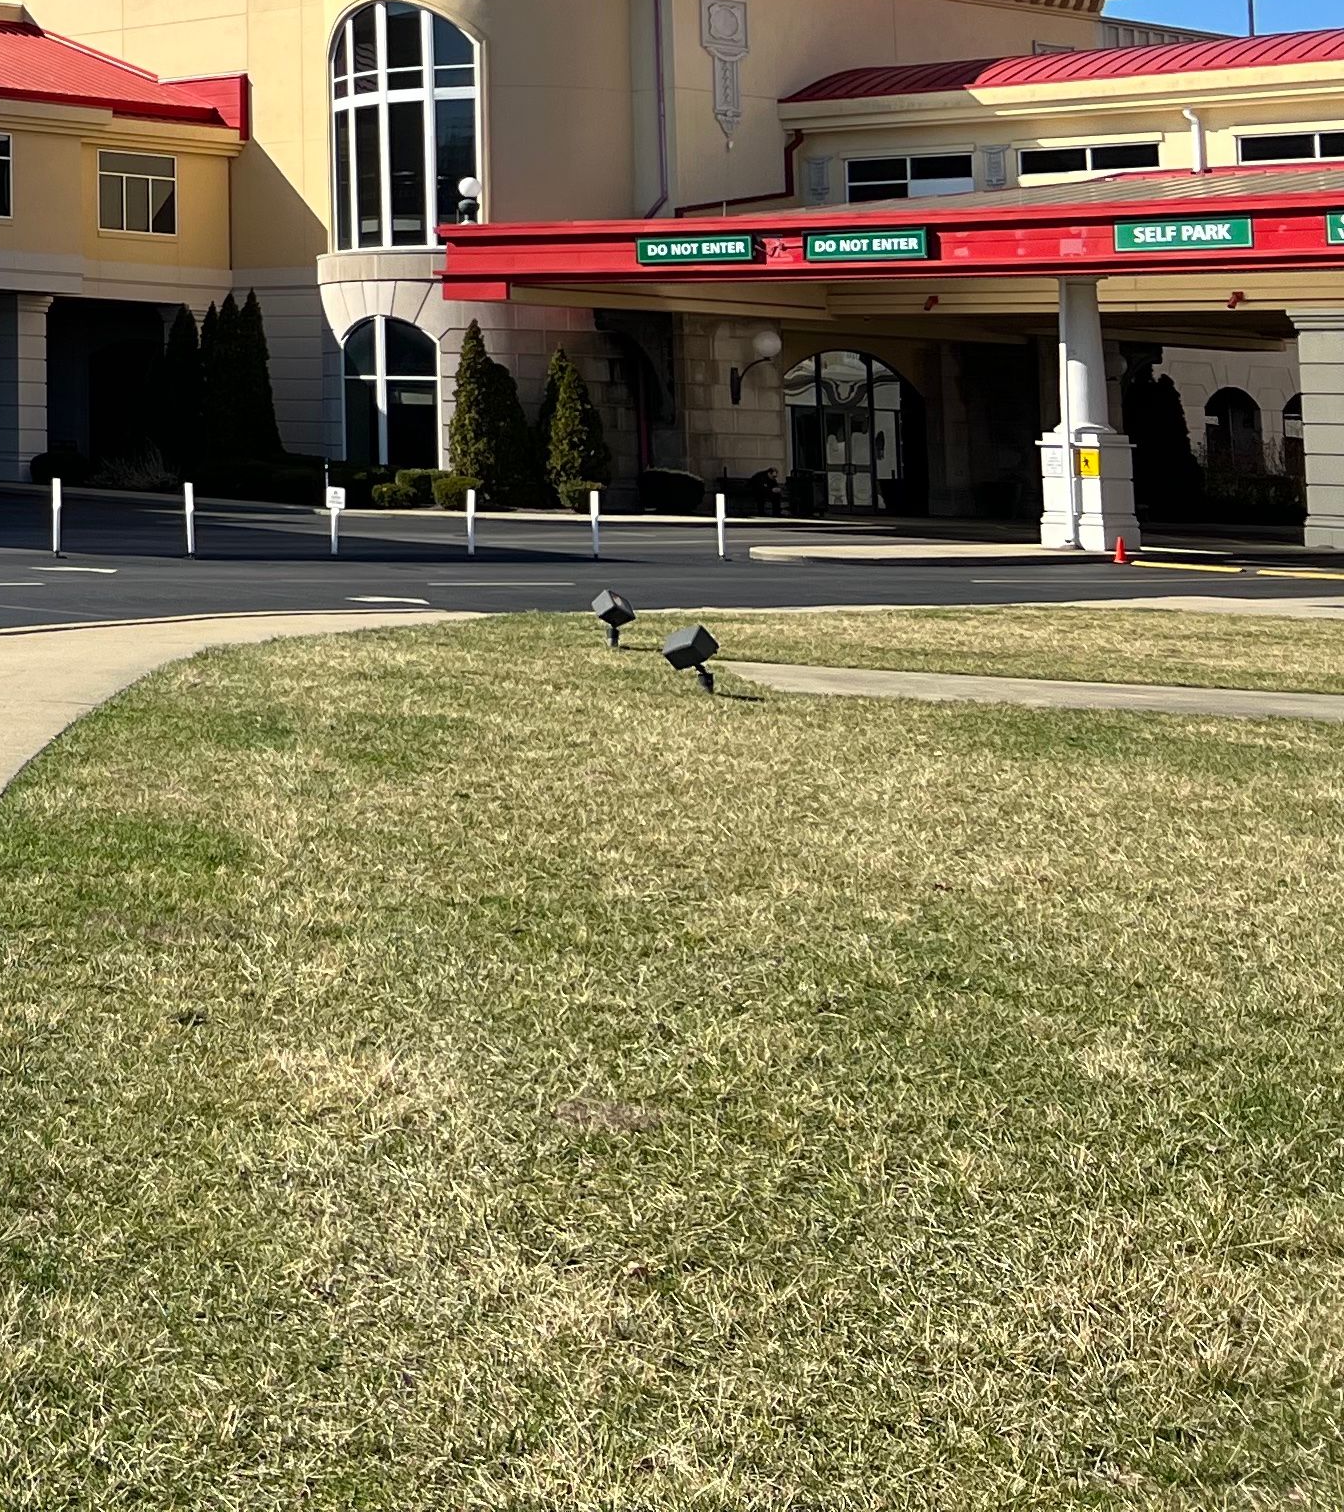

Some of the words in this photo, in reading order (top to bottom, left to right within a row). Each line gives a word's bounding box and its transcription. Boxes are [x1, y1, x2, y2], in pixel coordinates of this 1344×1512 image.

[1133, 225, 1177, 243] SELF
[1181, 223, 1232, 241] PARK
[647, 244, 668, 256] DO
[671, 243, 699, 255] NOT
[701, 241, 746, 254] ENTER
[814, 240, 837, 253] DO
[839, 239, 870, 252] NOT
[872, 237, 919, 251] ENTER
